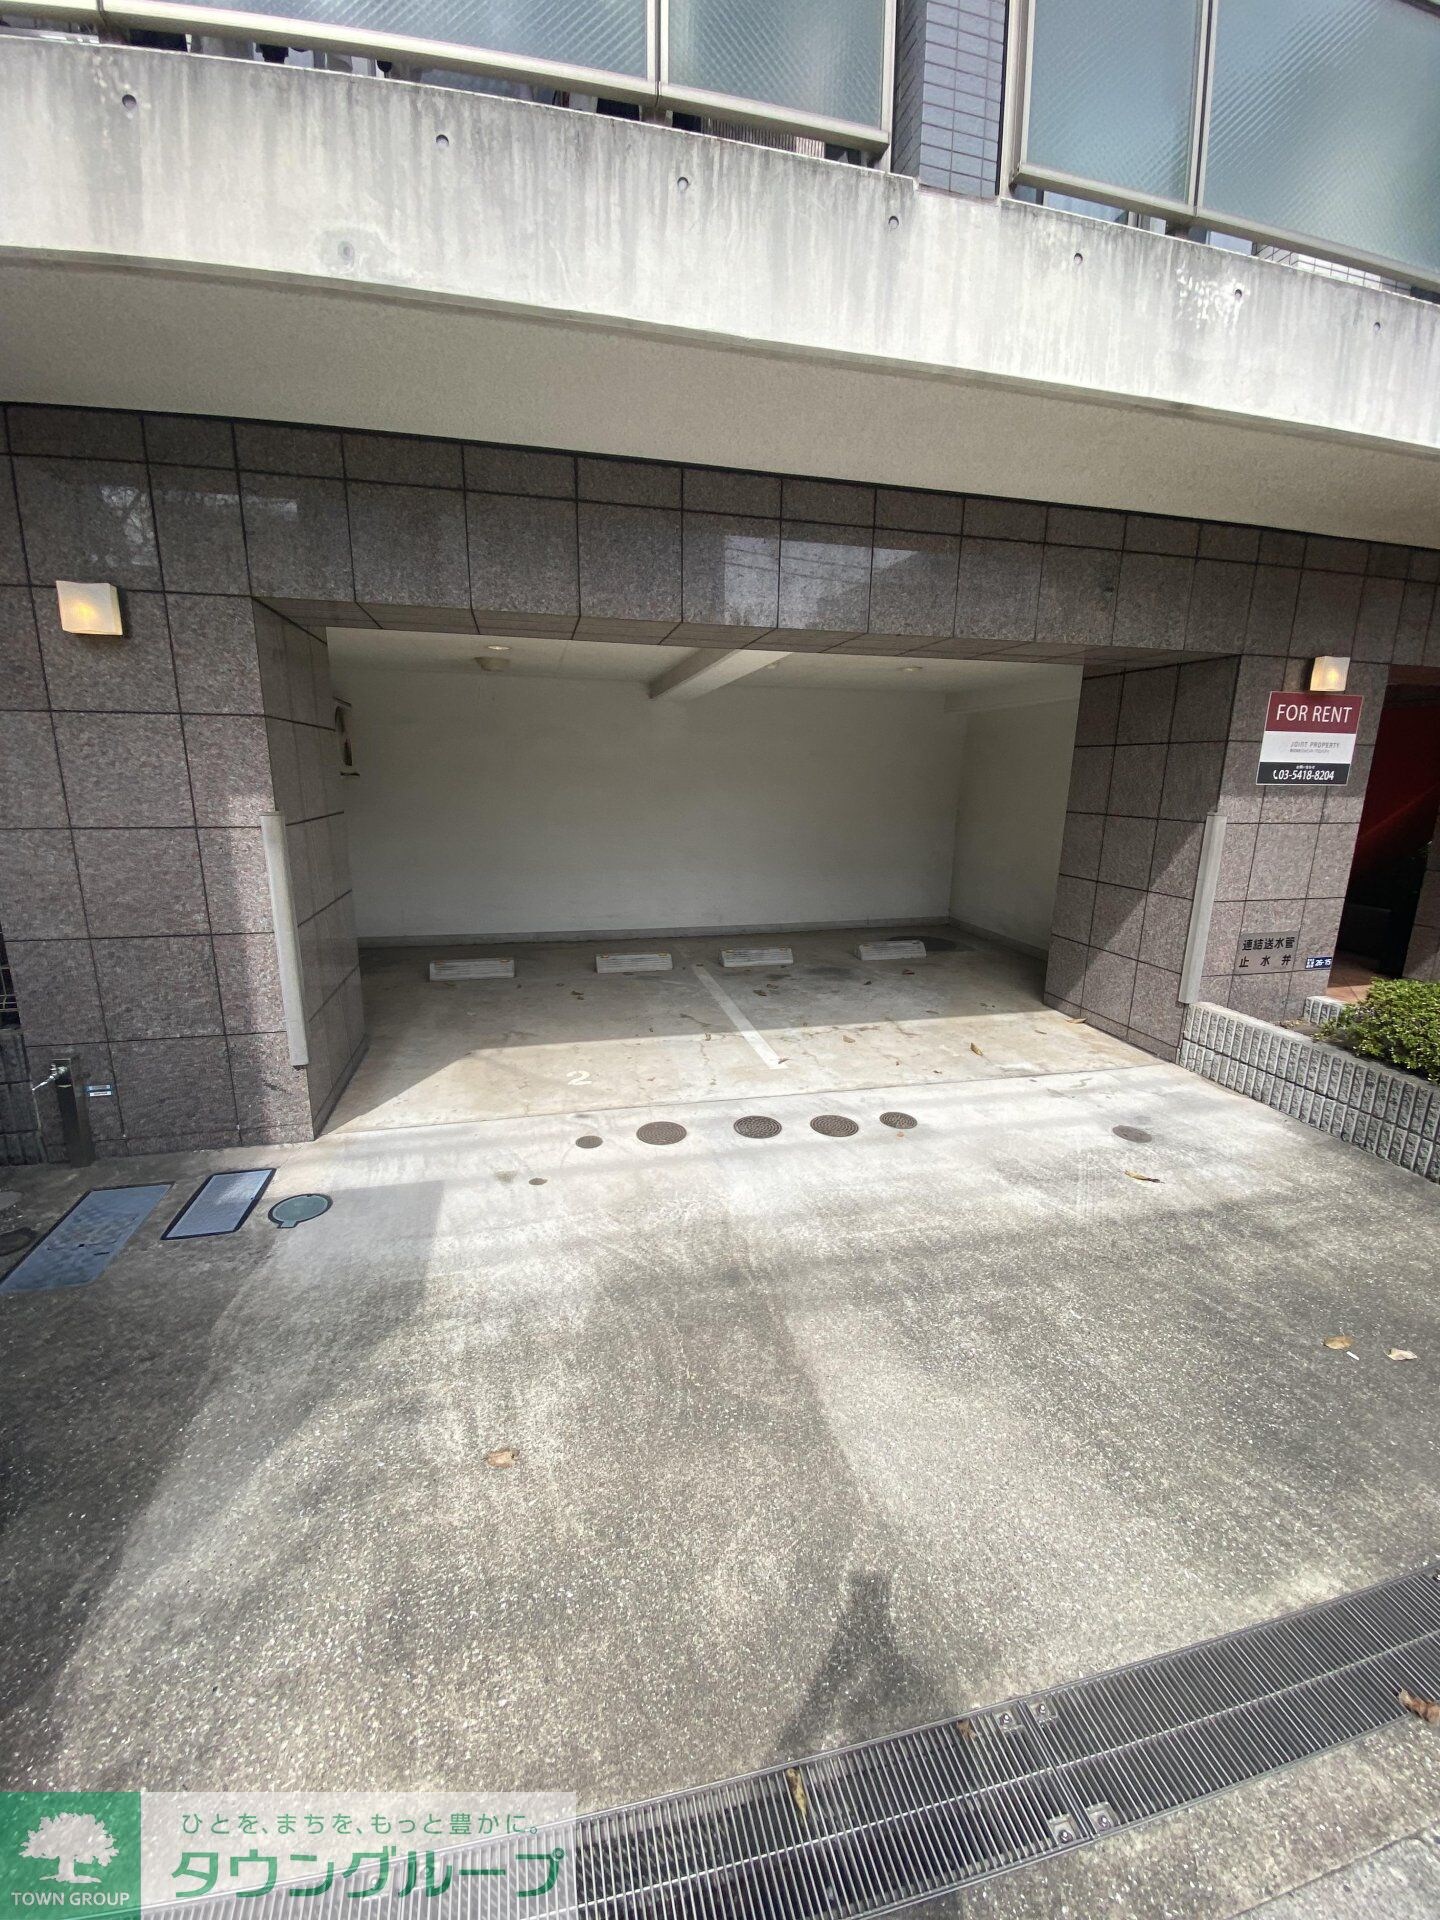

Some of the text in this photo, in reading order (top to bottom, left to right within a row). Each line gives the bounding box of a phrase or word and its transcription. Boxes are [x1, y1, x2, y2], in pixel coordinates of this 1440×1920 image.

[1276, 704, 1352, 723] FOR RENT
[1278, 769, 1334, 780] 03-5418-8204
[1242, 937, 1295, 951] 連結送水管
[566, 1070, 592, 1086] 2
